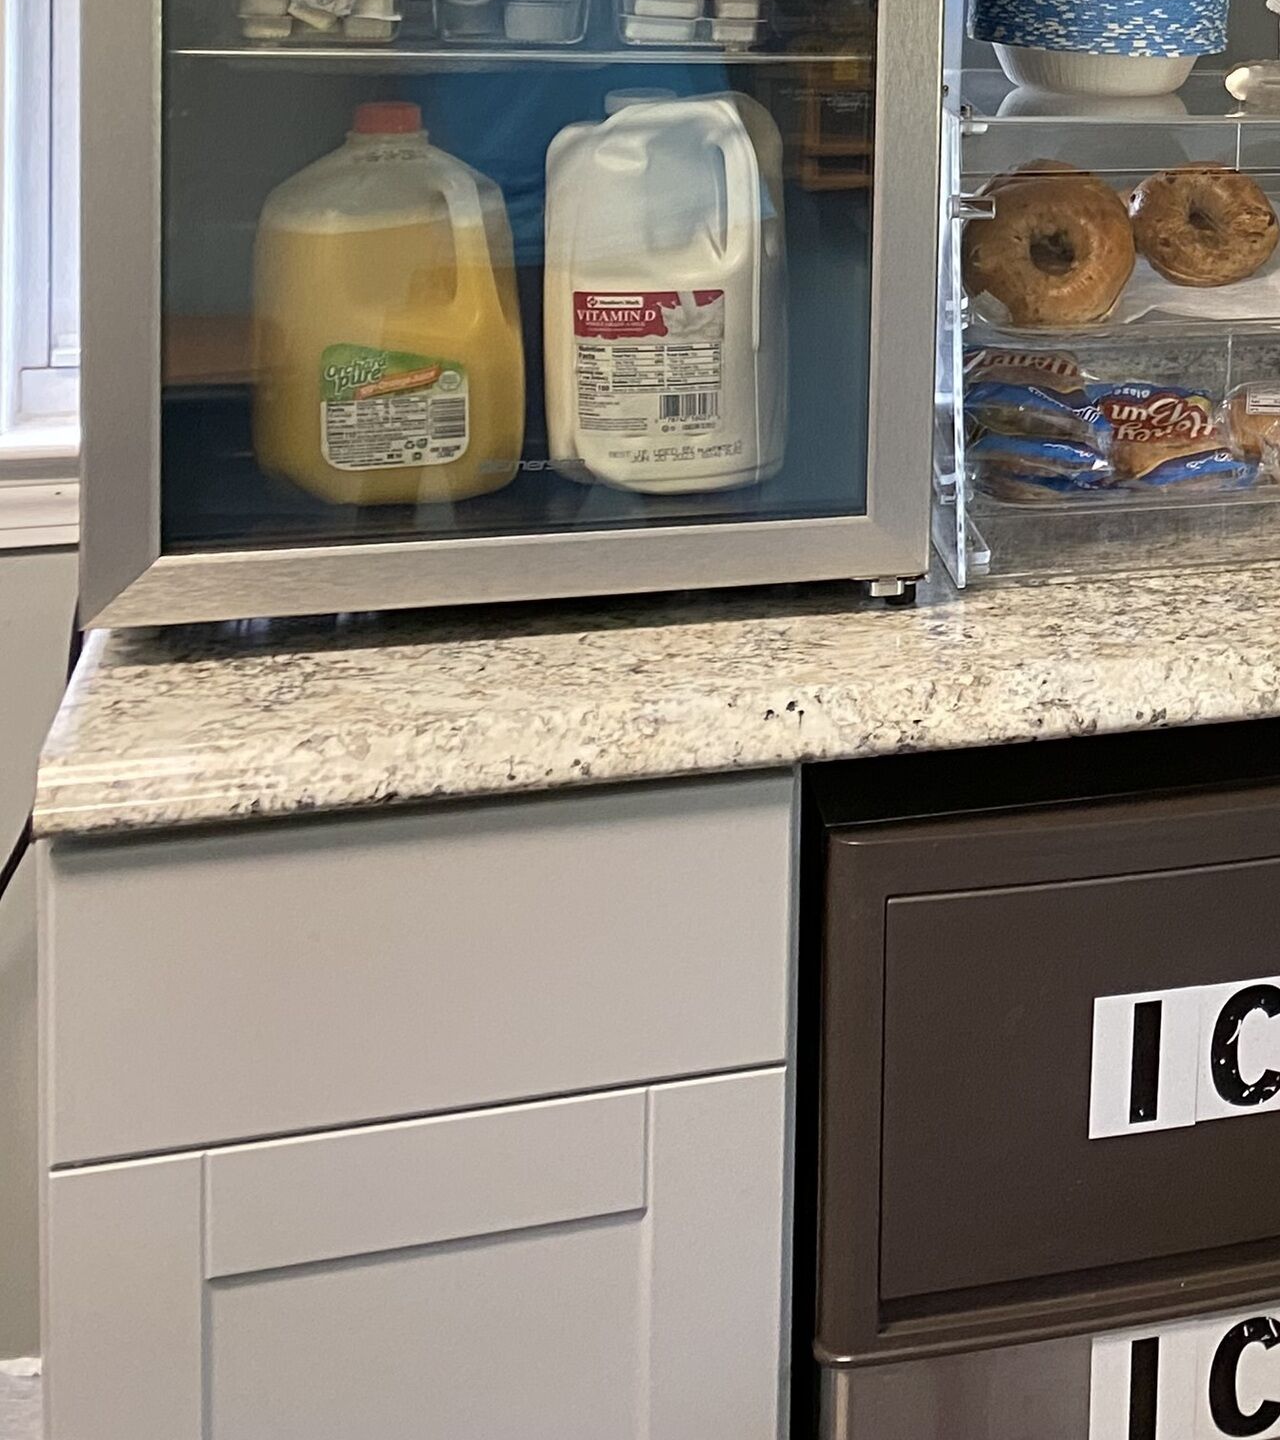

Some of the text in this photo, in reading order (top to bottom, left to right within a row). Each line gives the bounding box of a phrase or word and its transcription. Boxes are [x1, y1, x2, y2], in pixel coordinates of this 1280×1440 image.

[576, 310, 656, 322] VITAMIN D
[1112, 397, 1192, 427] Bun
[1116, 415, 1214, 442] Honey
